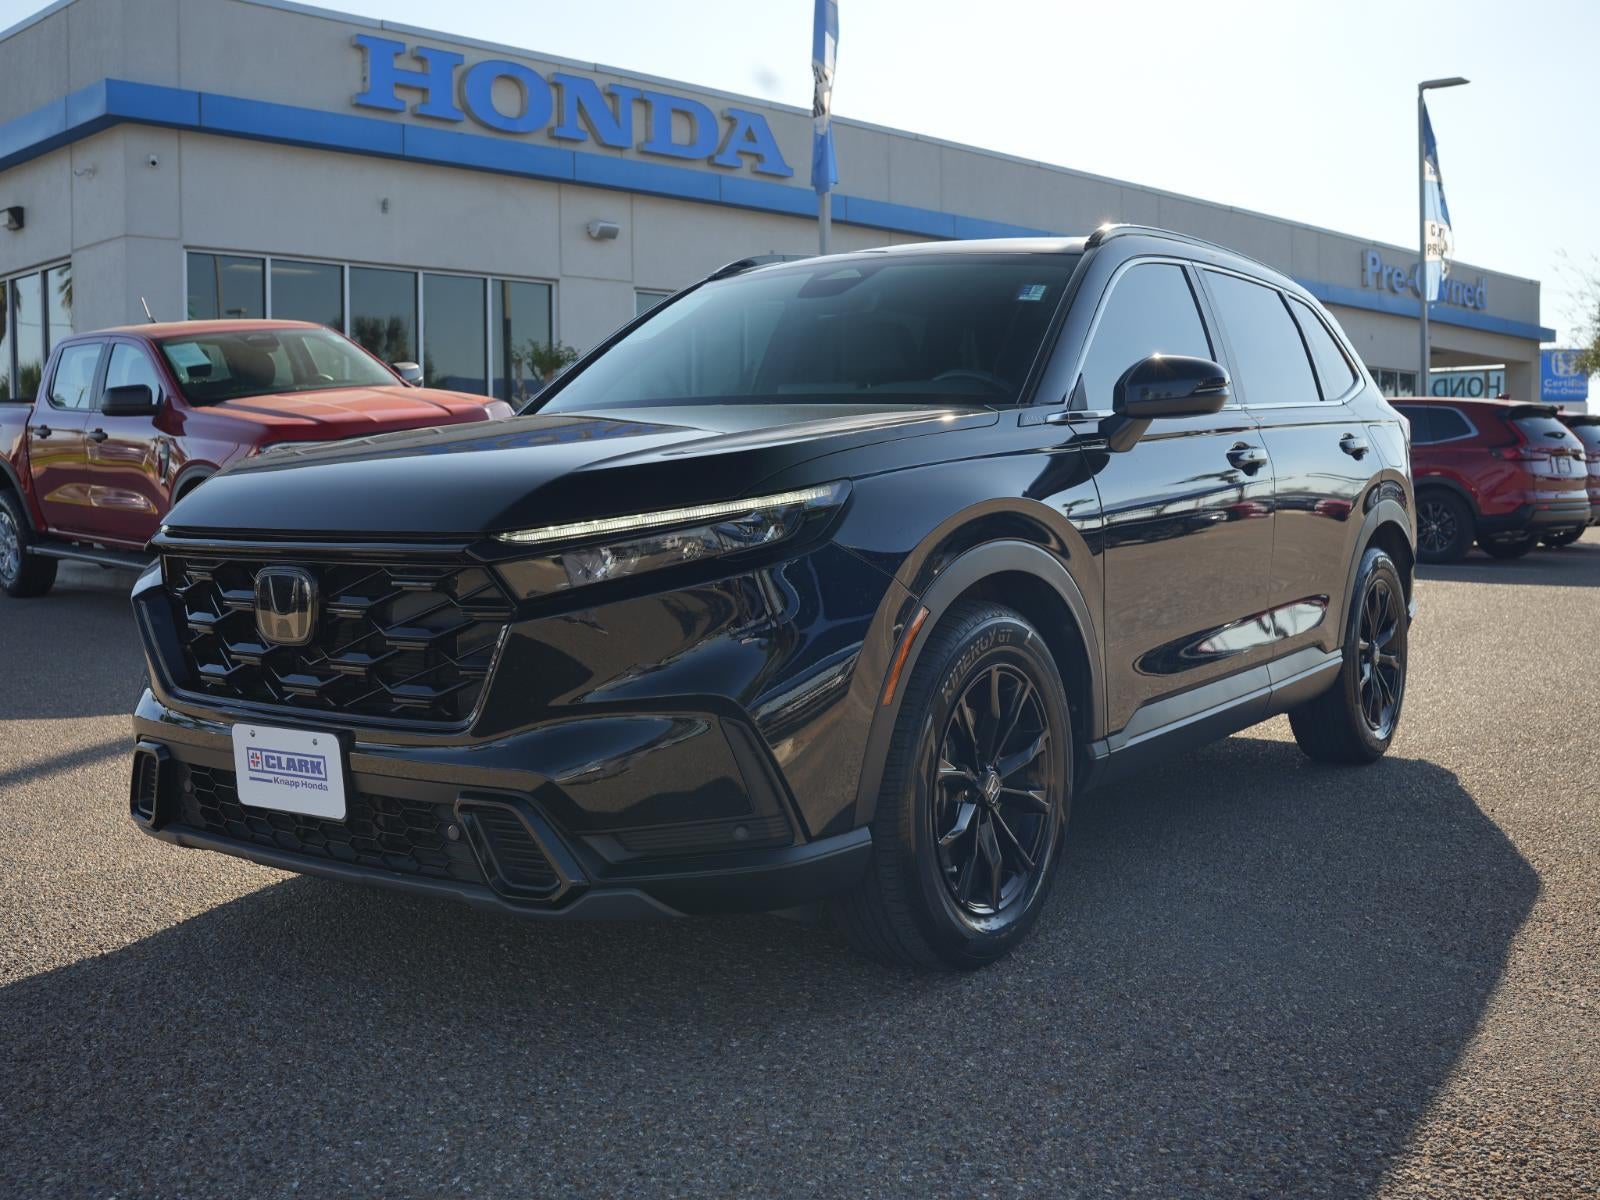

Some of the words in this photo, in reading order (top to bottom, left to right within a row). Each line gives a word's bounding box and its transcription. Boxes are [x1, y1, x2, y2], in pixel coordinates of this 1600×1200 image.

[352, 34, 793, 177] HONDA
[1362, 248, 1488, 310] Pre-ned
[265, 756, 322, 774] CLARK
[274, 777, 300, 788] Knapp
[302, 781, 328, 791] Honda
